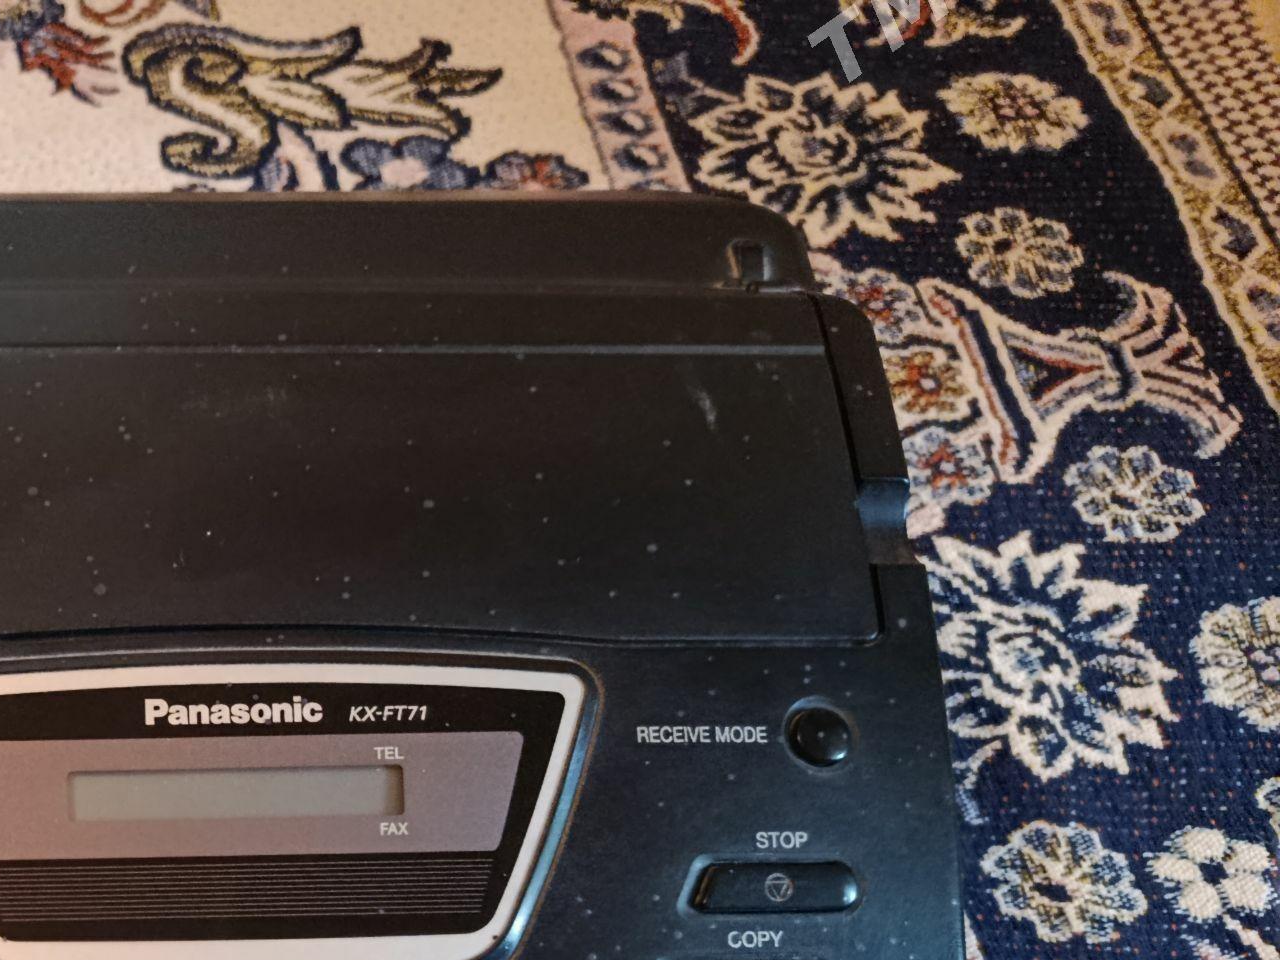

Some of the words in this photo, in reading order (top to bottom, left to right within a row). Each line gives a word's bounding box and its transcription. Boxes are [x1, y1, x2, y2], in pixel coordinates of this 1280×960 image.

[144, 696, 323, 726] Panasonic
[349, 705, 428, 723] KX-FT71
[636, 726, 711, 744] RECEIVE
[714, 726, 768, 744] MODE
[374, 746, 405, 761] TEL
[379, 822, 409, 836] FAX
[755, 831, 809, 849] STOP
[727, 931, 784, 949] COPY
